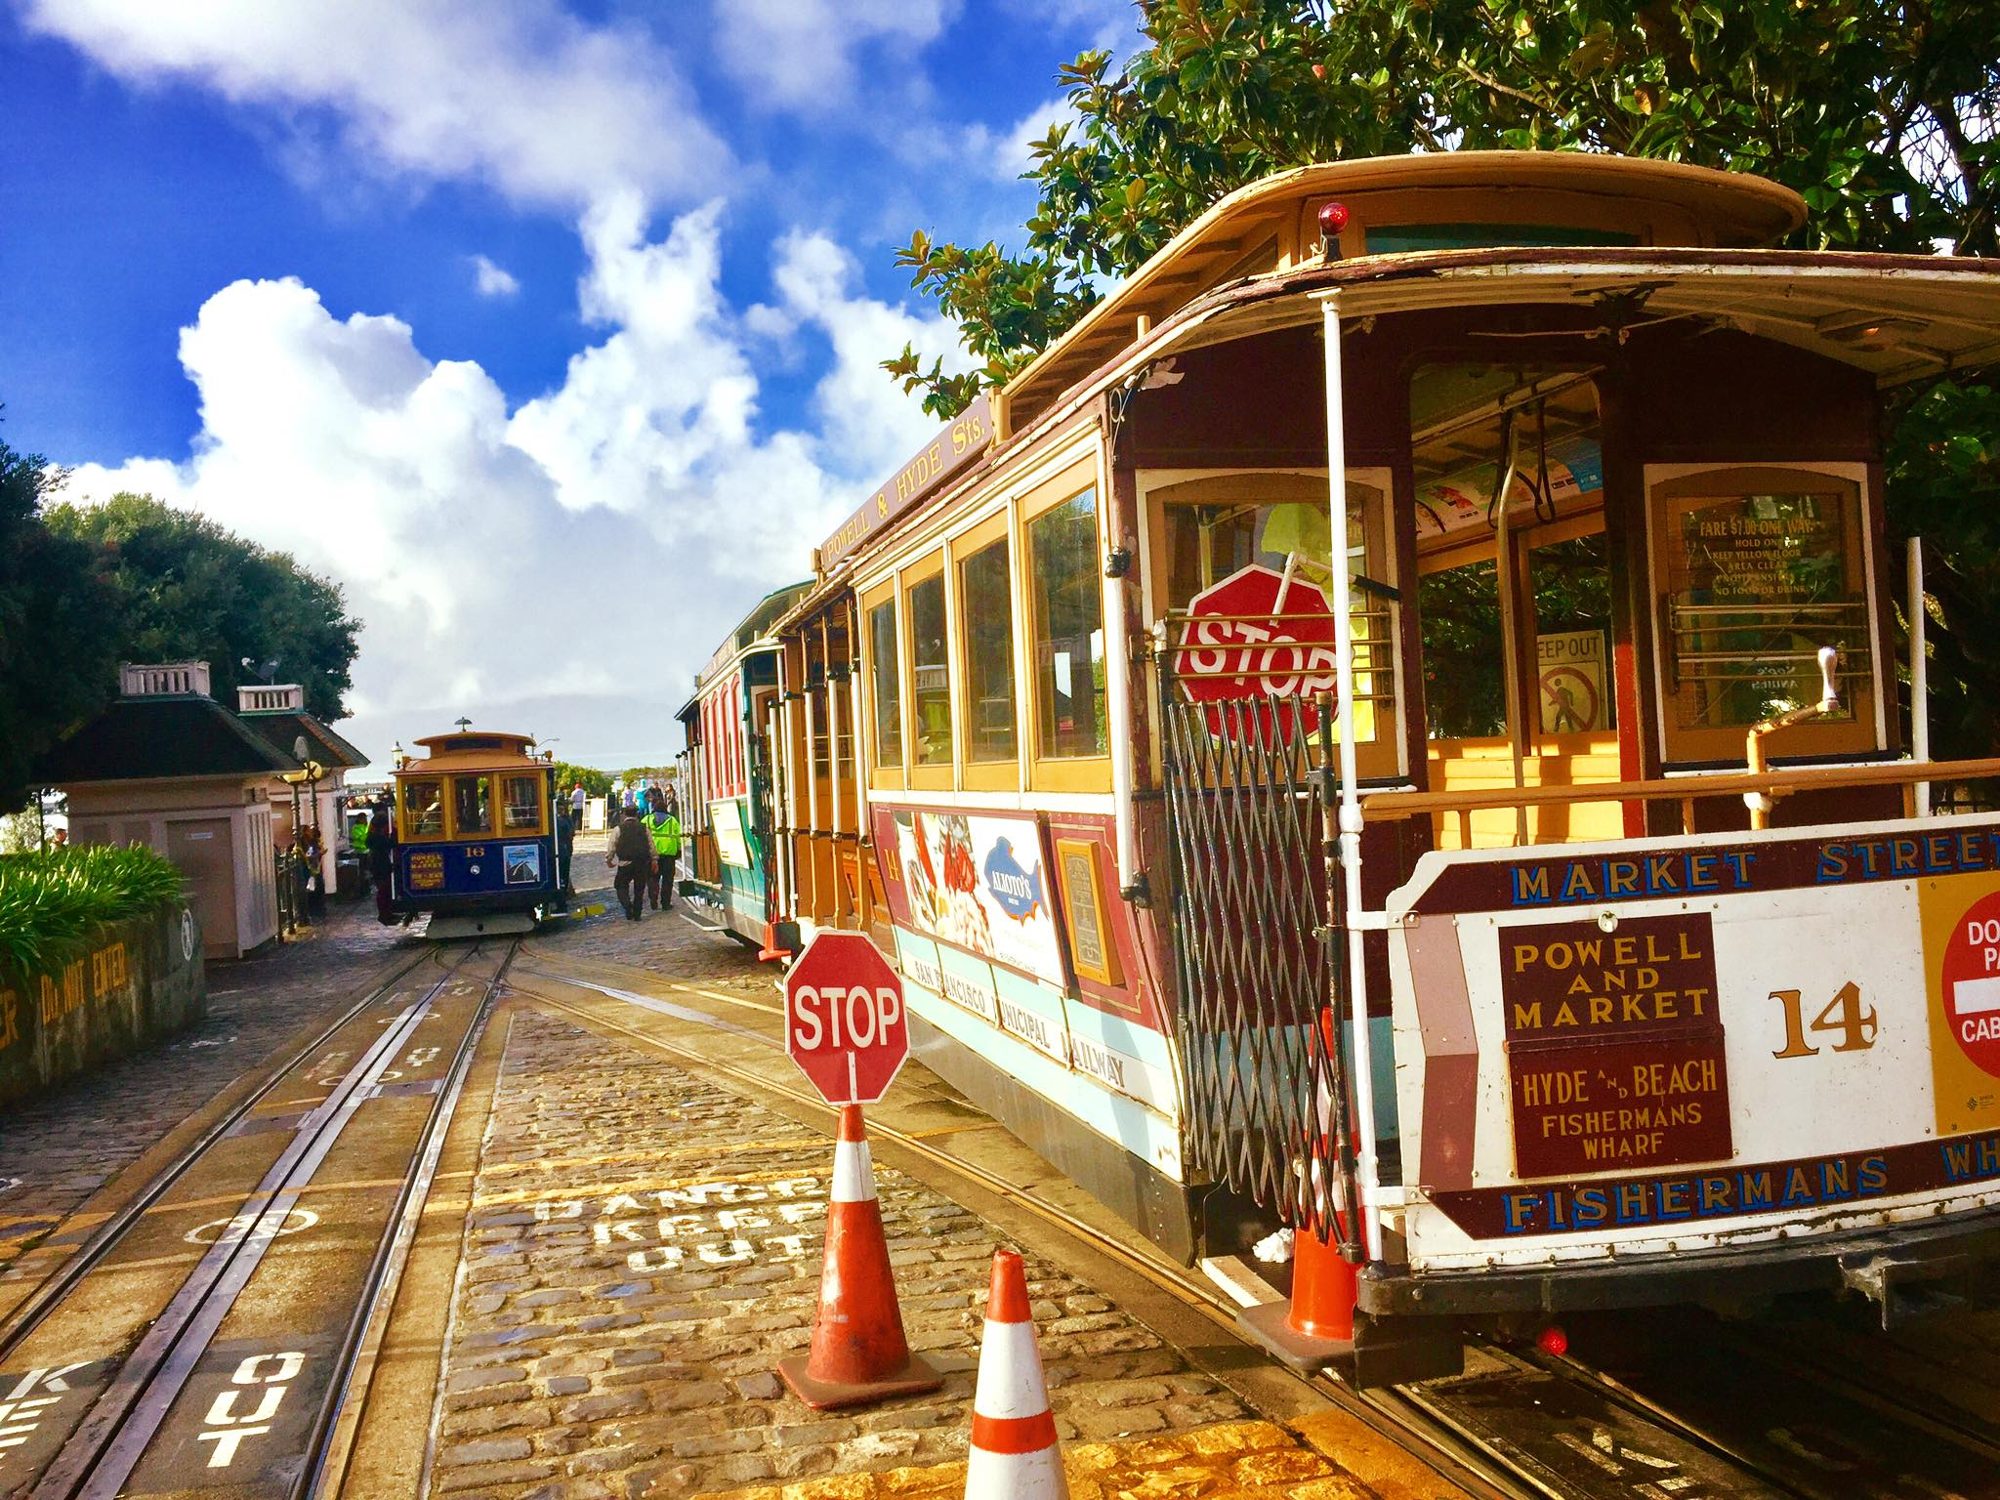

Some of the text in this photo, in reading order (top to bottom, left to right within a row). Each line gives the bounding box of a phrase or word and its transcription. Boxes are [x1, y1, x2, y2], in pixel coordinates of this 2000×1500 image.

[826, 415, 986, 562] POWELL & HYDE Sts.
[1700, 521, 1728, 536] FARE
[1760, 519, 1784, 535] ONE
[1735, 538, 1761, 548] HOLD
[1189, 612, 1338, 700] STOP
[1537, 636, 1599, 659] EEP OUT
[1512, 850, 1756, 905] MARKET
[1513, 933, 1702, 973] POWELL
[1567, 967, 1660, 995] AND
[795, 985, 899, 1050] STOP
[915, 960, 934, 986] SAN
[934, 969, 986, 1013] FANCISCO
[991, 995, 1050, 1049] UNICIPAL
[1514, 988, 1709, 1030] MARKET
[1768, 981, 1878, 1059] 14
[1523, 1059, 1718, 1107] HYDE AND BEACH
[1542, 1103, 1702, 1138] FISHERMANS
[1583, 1132, 1665, 1160] WHARF
[534, 1176, 835, 1220] DANGE
[1504, 1156, 1890, 1233] FISHERMANS
[593, 1202, 828, 1245] KEEP
[627, 1232, 817, 1273] OUT
[197, 1352, 306, 1468] OUT
